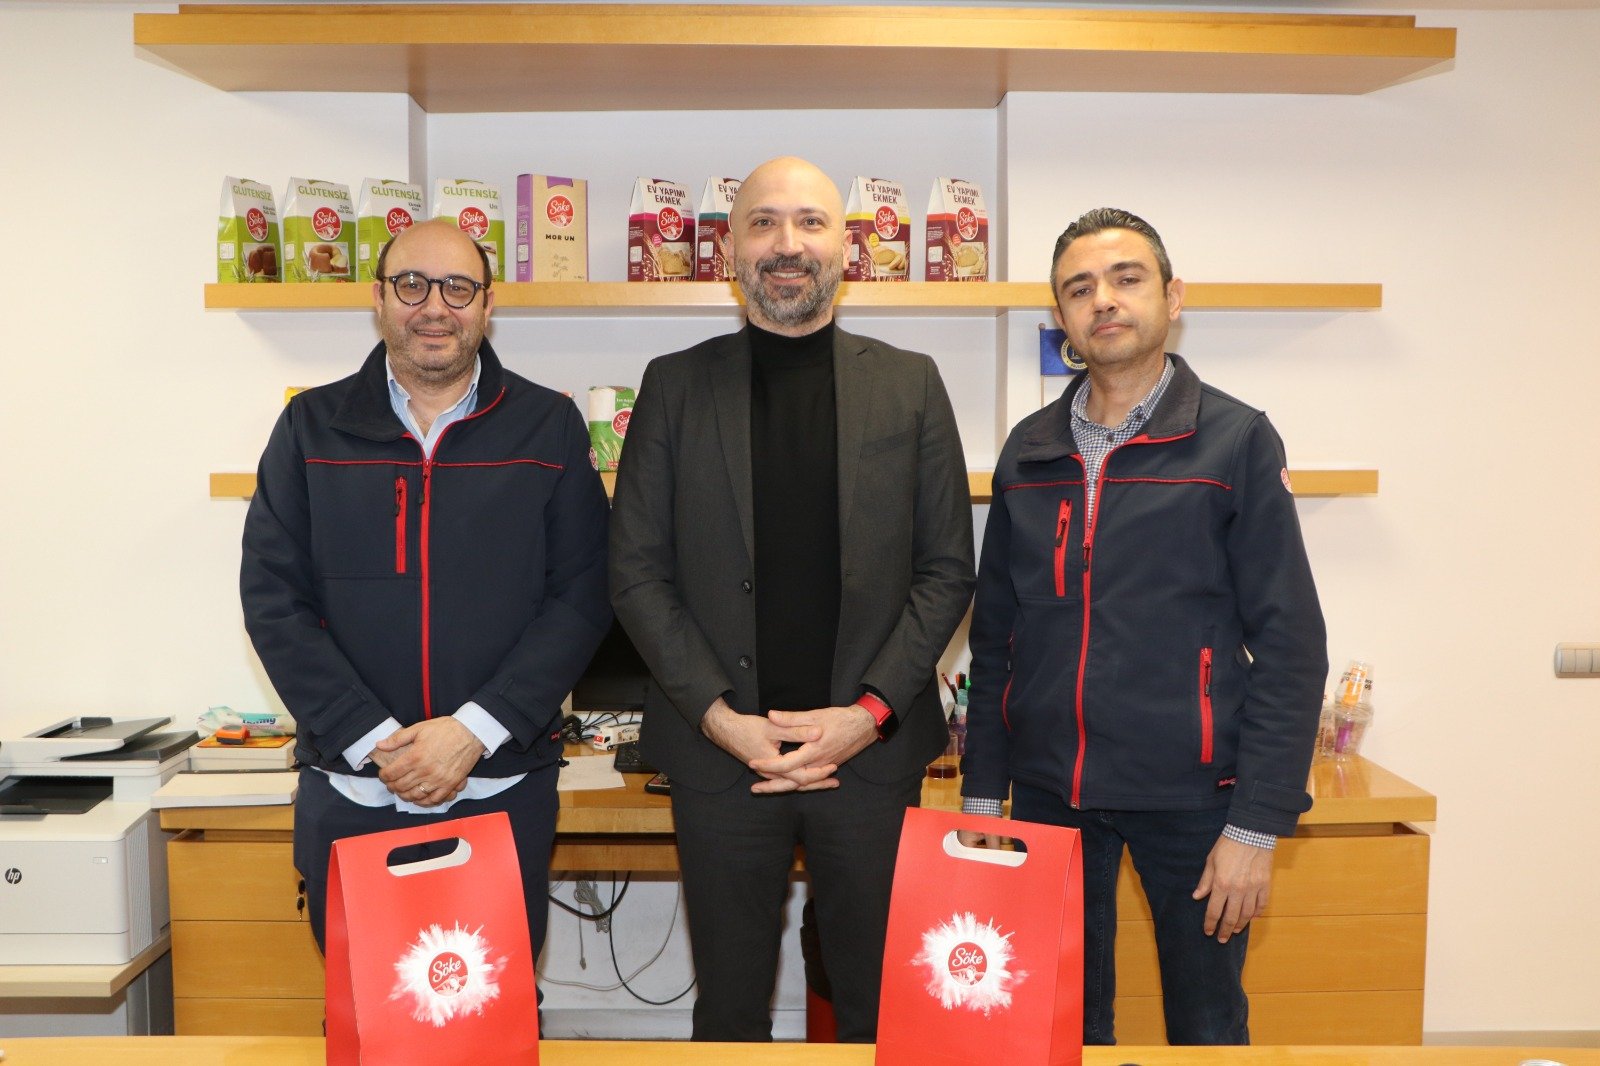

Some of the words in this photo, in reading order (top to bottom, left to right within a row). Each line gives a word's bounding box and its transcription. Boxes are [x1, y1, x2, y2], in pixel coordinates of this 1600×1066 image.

[298, 185, 350, 200] GLUTENSİZ
[371, 186, 422, 201] GLUTENSİZ
[443, 186, 499, 200] GLUTENSİZ
[646, 185, 657, 193] EV
[659, 187, 686, 198] YAPIMI
[718, 184, 727, 193] EV
[865, 183, 875, 192] EV
[877, 185, 902, 196] YAPIMI
[946, 184, 955, 193] EV
[956, 186, 980, 198] YAPIMI
[655, 195, 682, 205] EKMEK
[872, 194, 898, 204] EKMEK
[953, 195, 976, 205] EKMEK
[549, 200, 570, 215] Söke
[315, 211, 337, 226] Söke
[389, 211, 410, 226] Söke
[461, 211, 484, 226] Söke
[660, 211, 679, 226] Söke
[877, 210, 895, 225] Söke
[6, 867, 22, 884] hp
[952, 947, 983, 967] Söke
[432, 956, 461, 982] Söke
